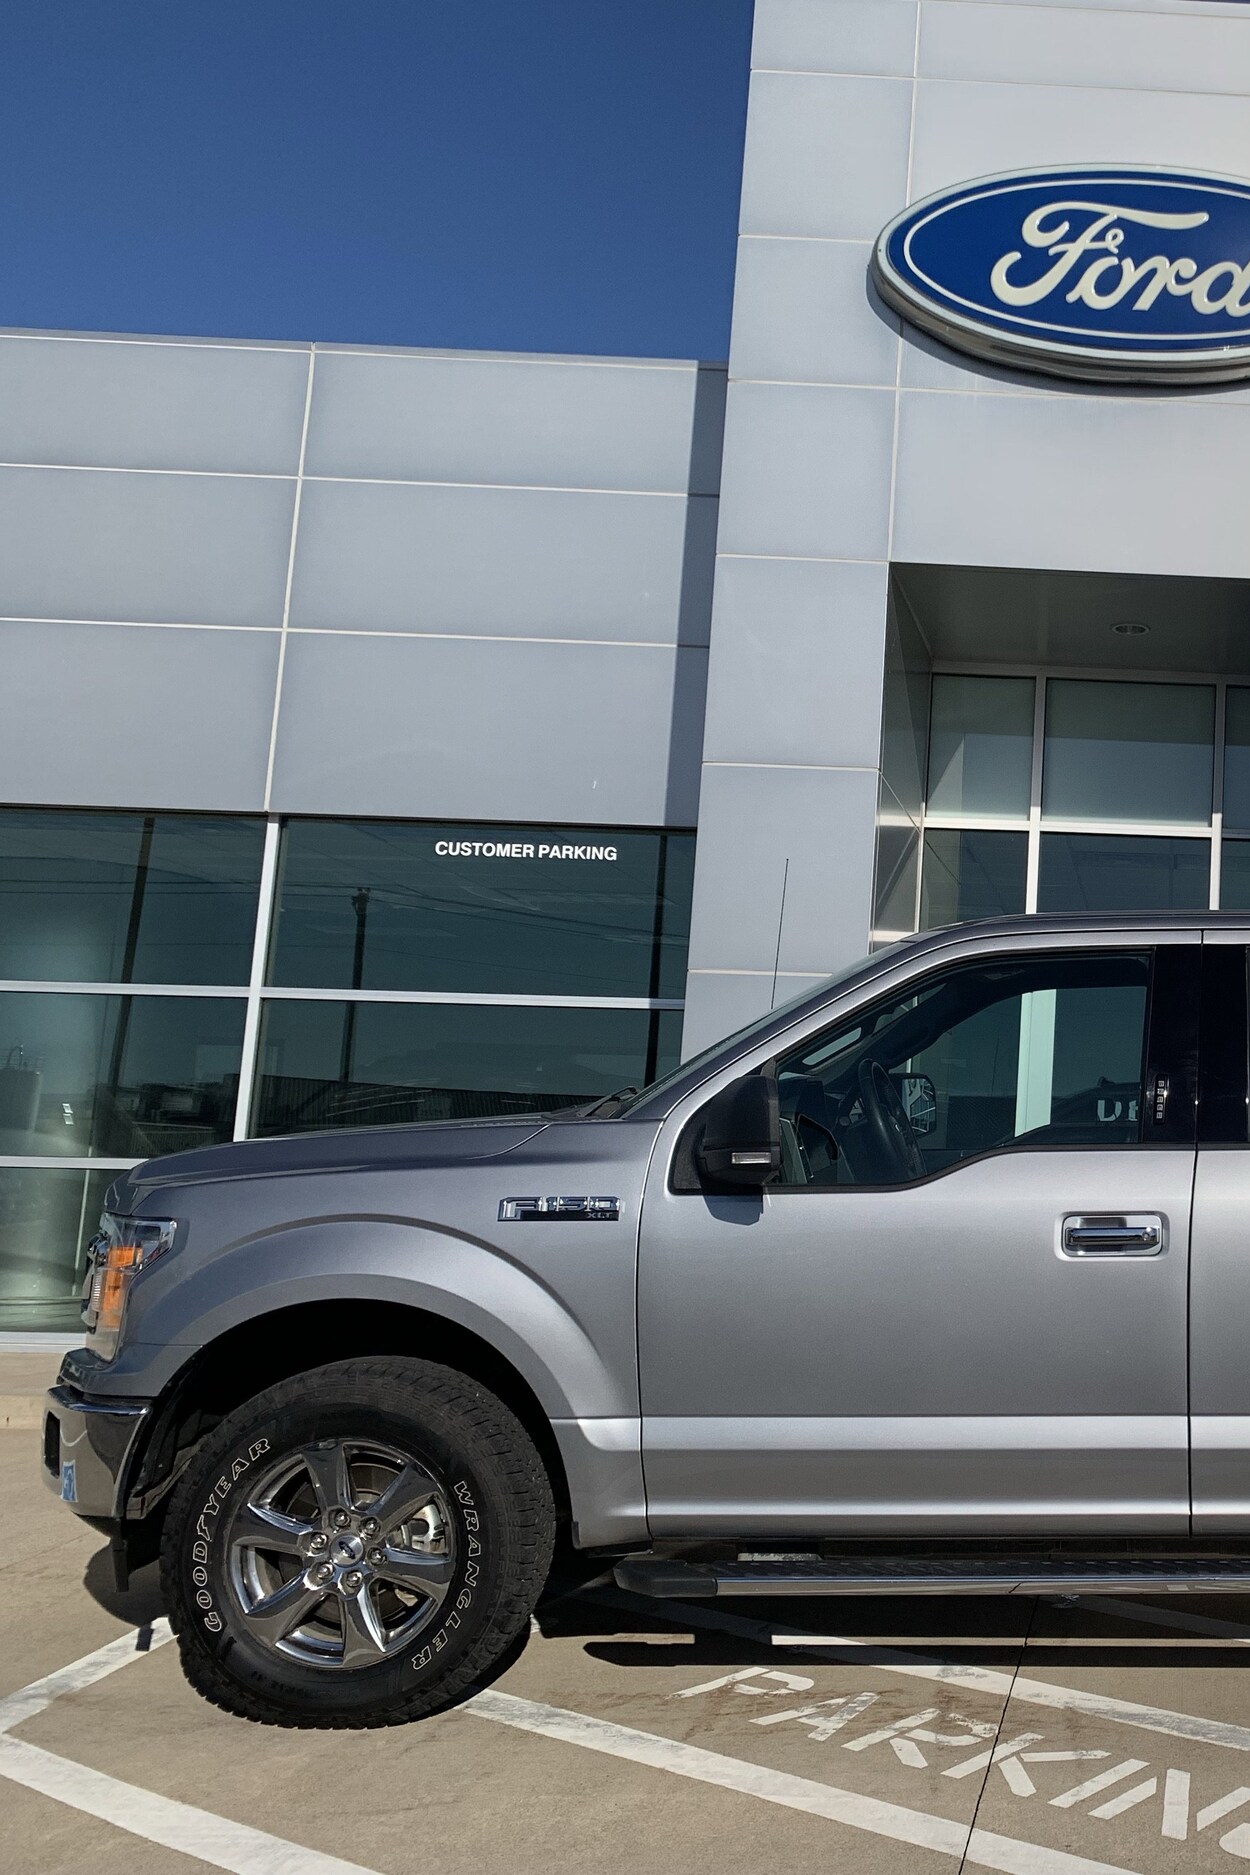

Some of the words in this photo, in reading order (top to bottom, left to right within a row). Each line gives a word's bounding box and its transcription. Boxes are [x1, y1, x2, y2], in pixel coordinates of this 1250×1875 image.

[435, 841, 535, 858] CUSTOMER
[538, 845, 617, 861] PARKING
[192, 1438, 271, 1632] GOODYEAR
[411, 1480, 481, 1670] WRANGLER
